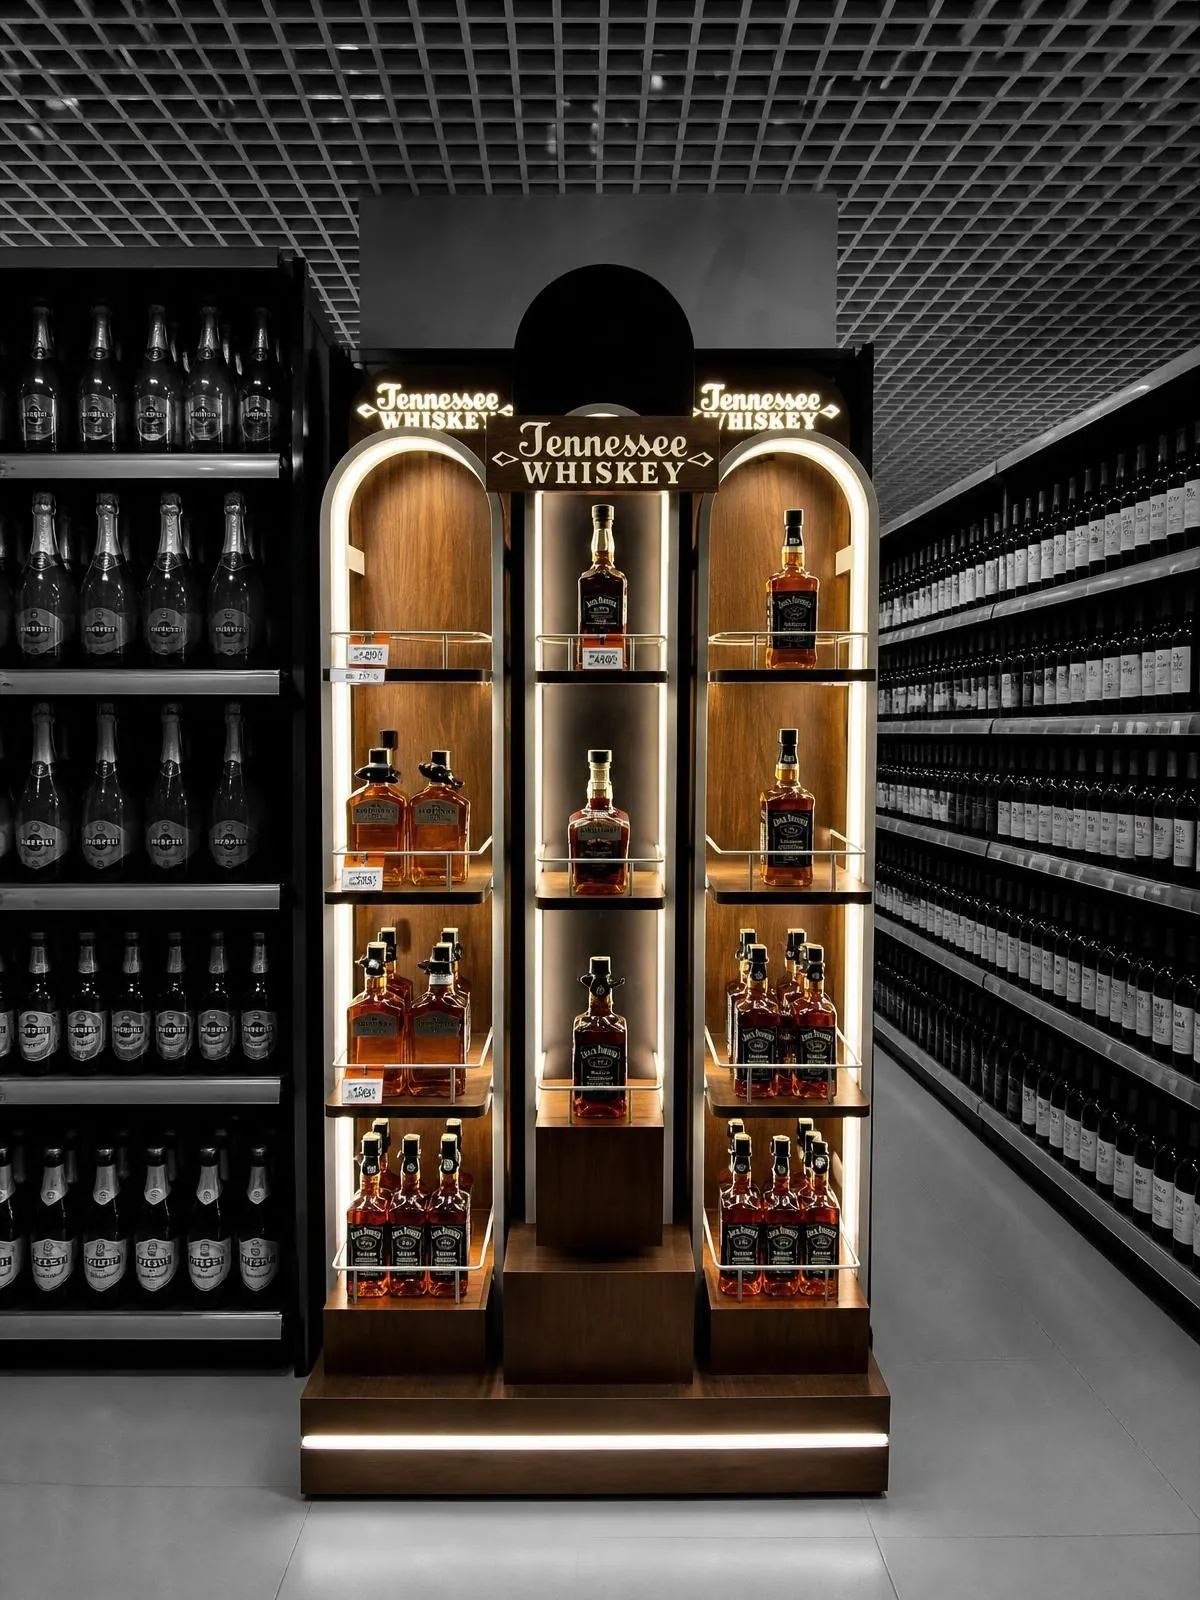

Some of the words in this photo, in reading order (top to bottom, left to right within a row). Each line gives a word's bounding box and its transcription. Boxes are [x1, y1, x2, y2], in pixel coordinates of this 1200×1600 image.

[376, 382, 500, 411] Tennessee
[700, 383, 821, 411] Tennessee
[518, 421, 688, 457] Tennessee
[522, 461, 685, 484] WHISKEY
